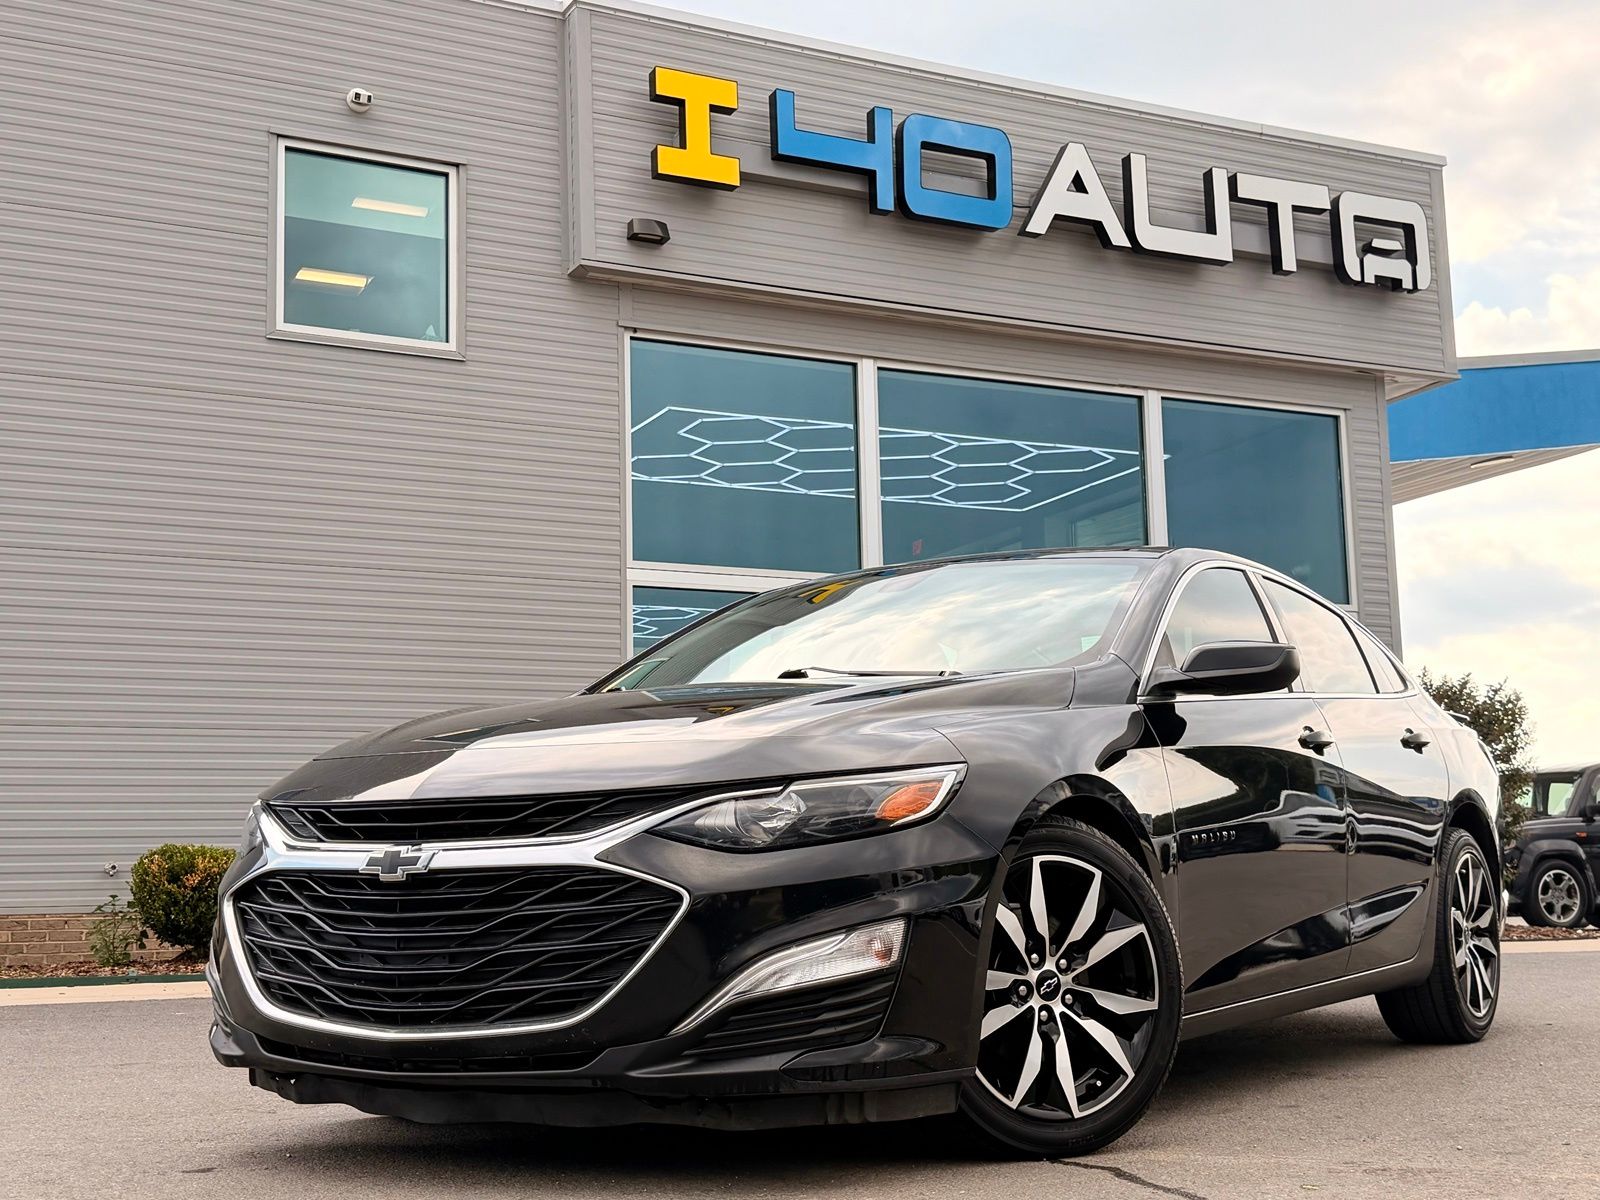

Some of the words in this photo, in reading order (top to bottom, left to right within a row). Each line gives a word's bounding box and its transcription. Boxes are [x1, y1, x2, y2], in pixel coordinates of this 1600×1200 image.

[649, 66, 741, 190] I
[769, 88, 1013, 230] 40
[1191, 830, 1236, 844] MALIBU
